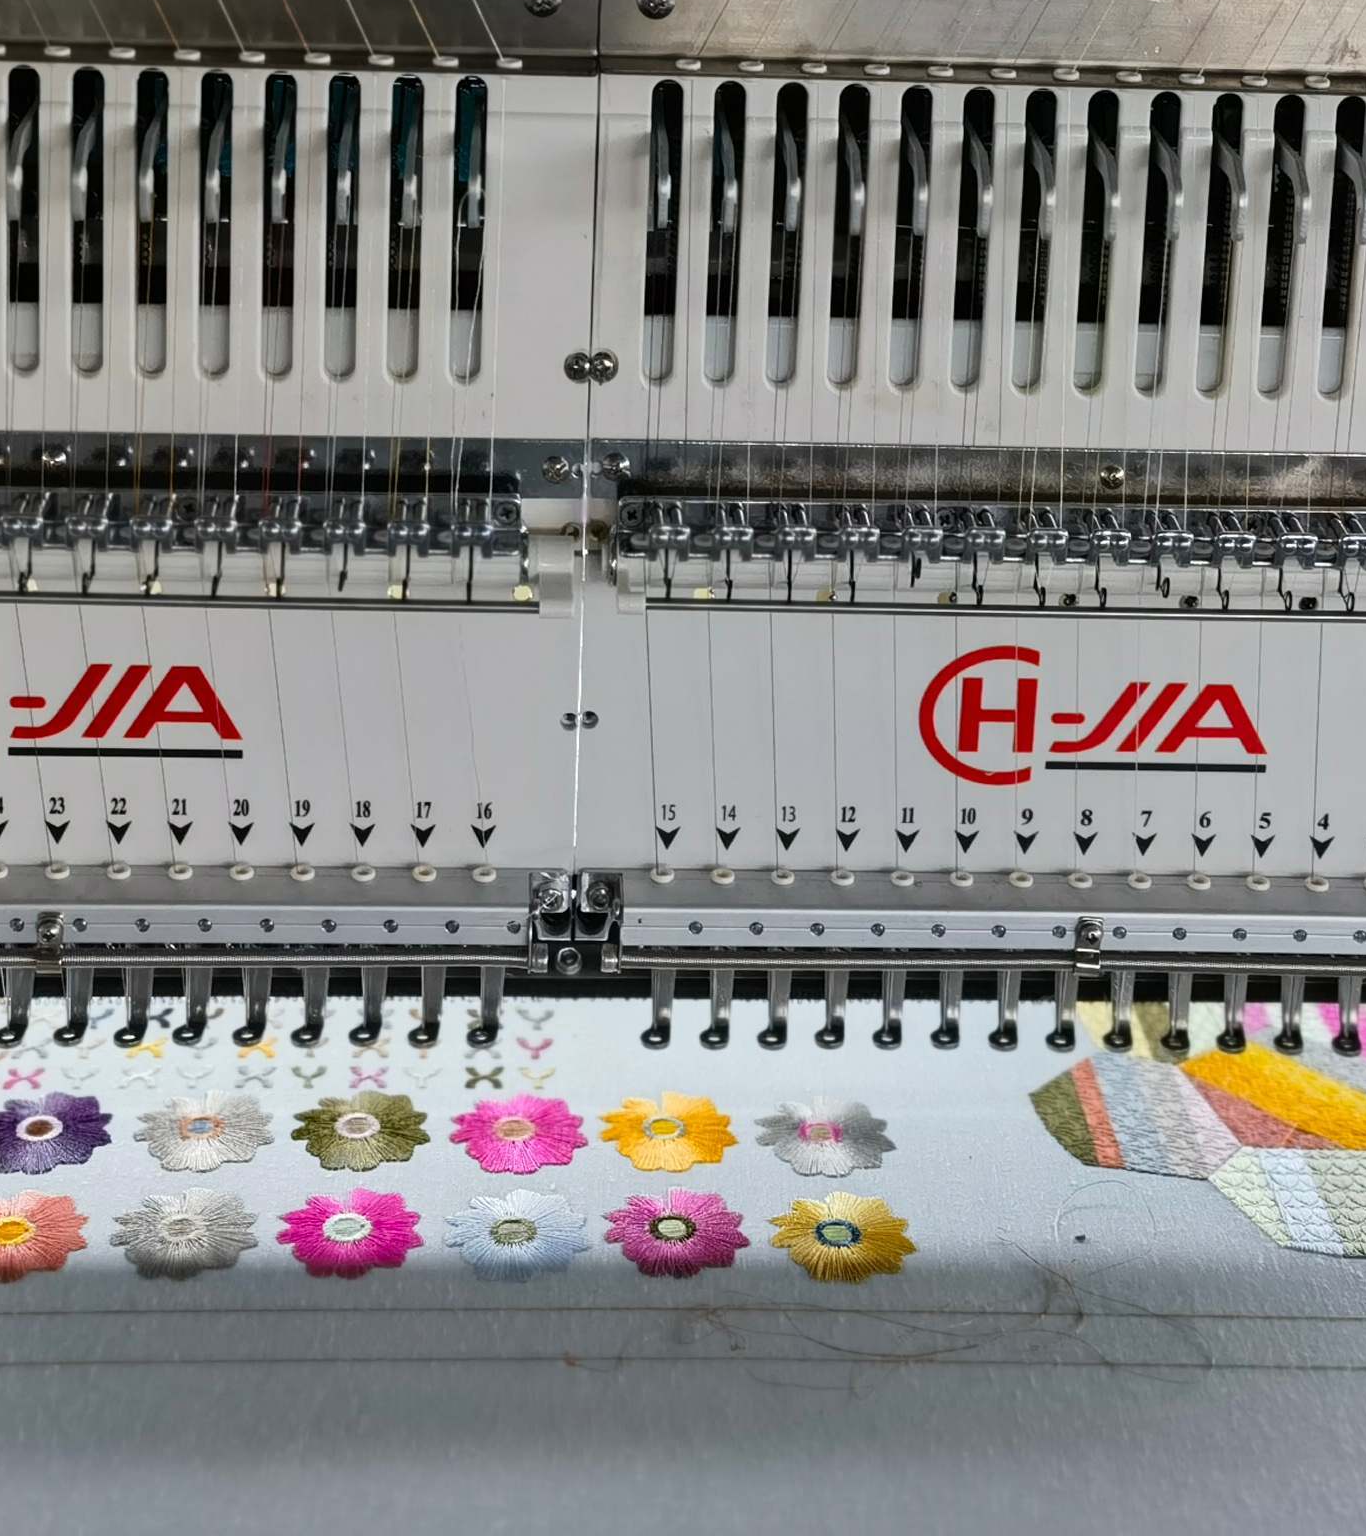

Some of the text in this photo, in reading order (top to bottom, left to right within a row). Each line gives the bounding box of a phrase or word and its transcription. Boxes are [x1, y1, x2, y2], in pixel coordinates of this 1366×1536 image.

[49, 797, 65, 815] 23
[110, 798, 127, 816] 22
[171, 798, 188, 816] 21
[233, 799, 250, 817] 20
[294, 800, 311, 817] 19
[355, 801, 372, 818] 18
[416, 802, 432, 819] 17
[477, 802, 493, 819] 16
[660, 804, 676, 821] 15
[721, 804, 736, 822] 14
[781, 805, 797, 823] 13
[841, 806, 856, 823] 12
[901, 807, 915, 824] 11
[961, 808, 977, 825] 10
[1021, 808, 1034, 825] 9
[1080, 809, 1094, 827] 8
[1140, 810, 1153, 828] 7
[1199, 811, 1212, 829] 6
[1259, 812, 1272, 830] 5
[1317, 813, 1330, 831] 4
